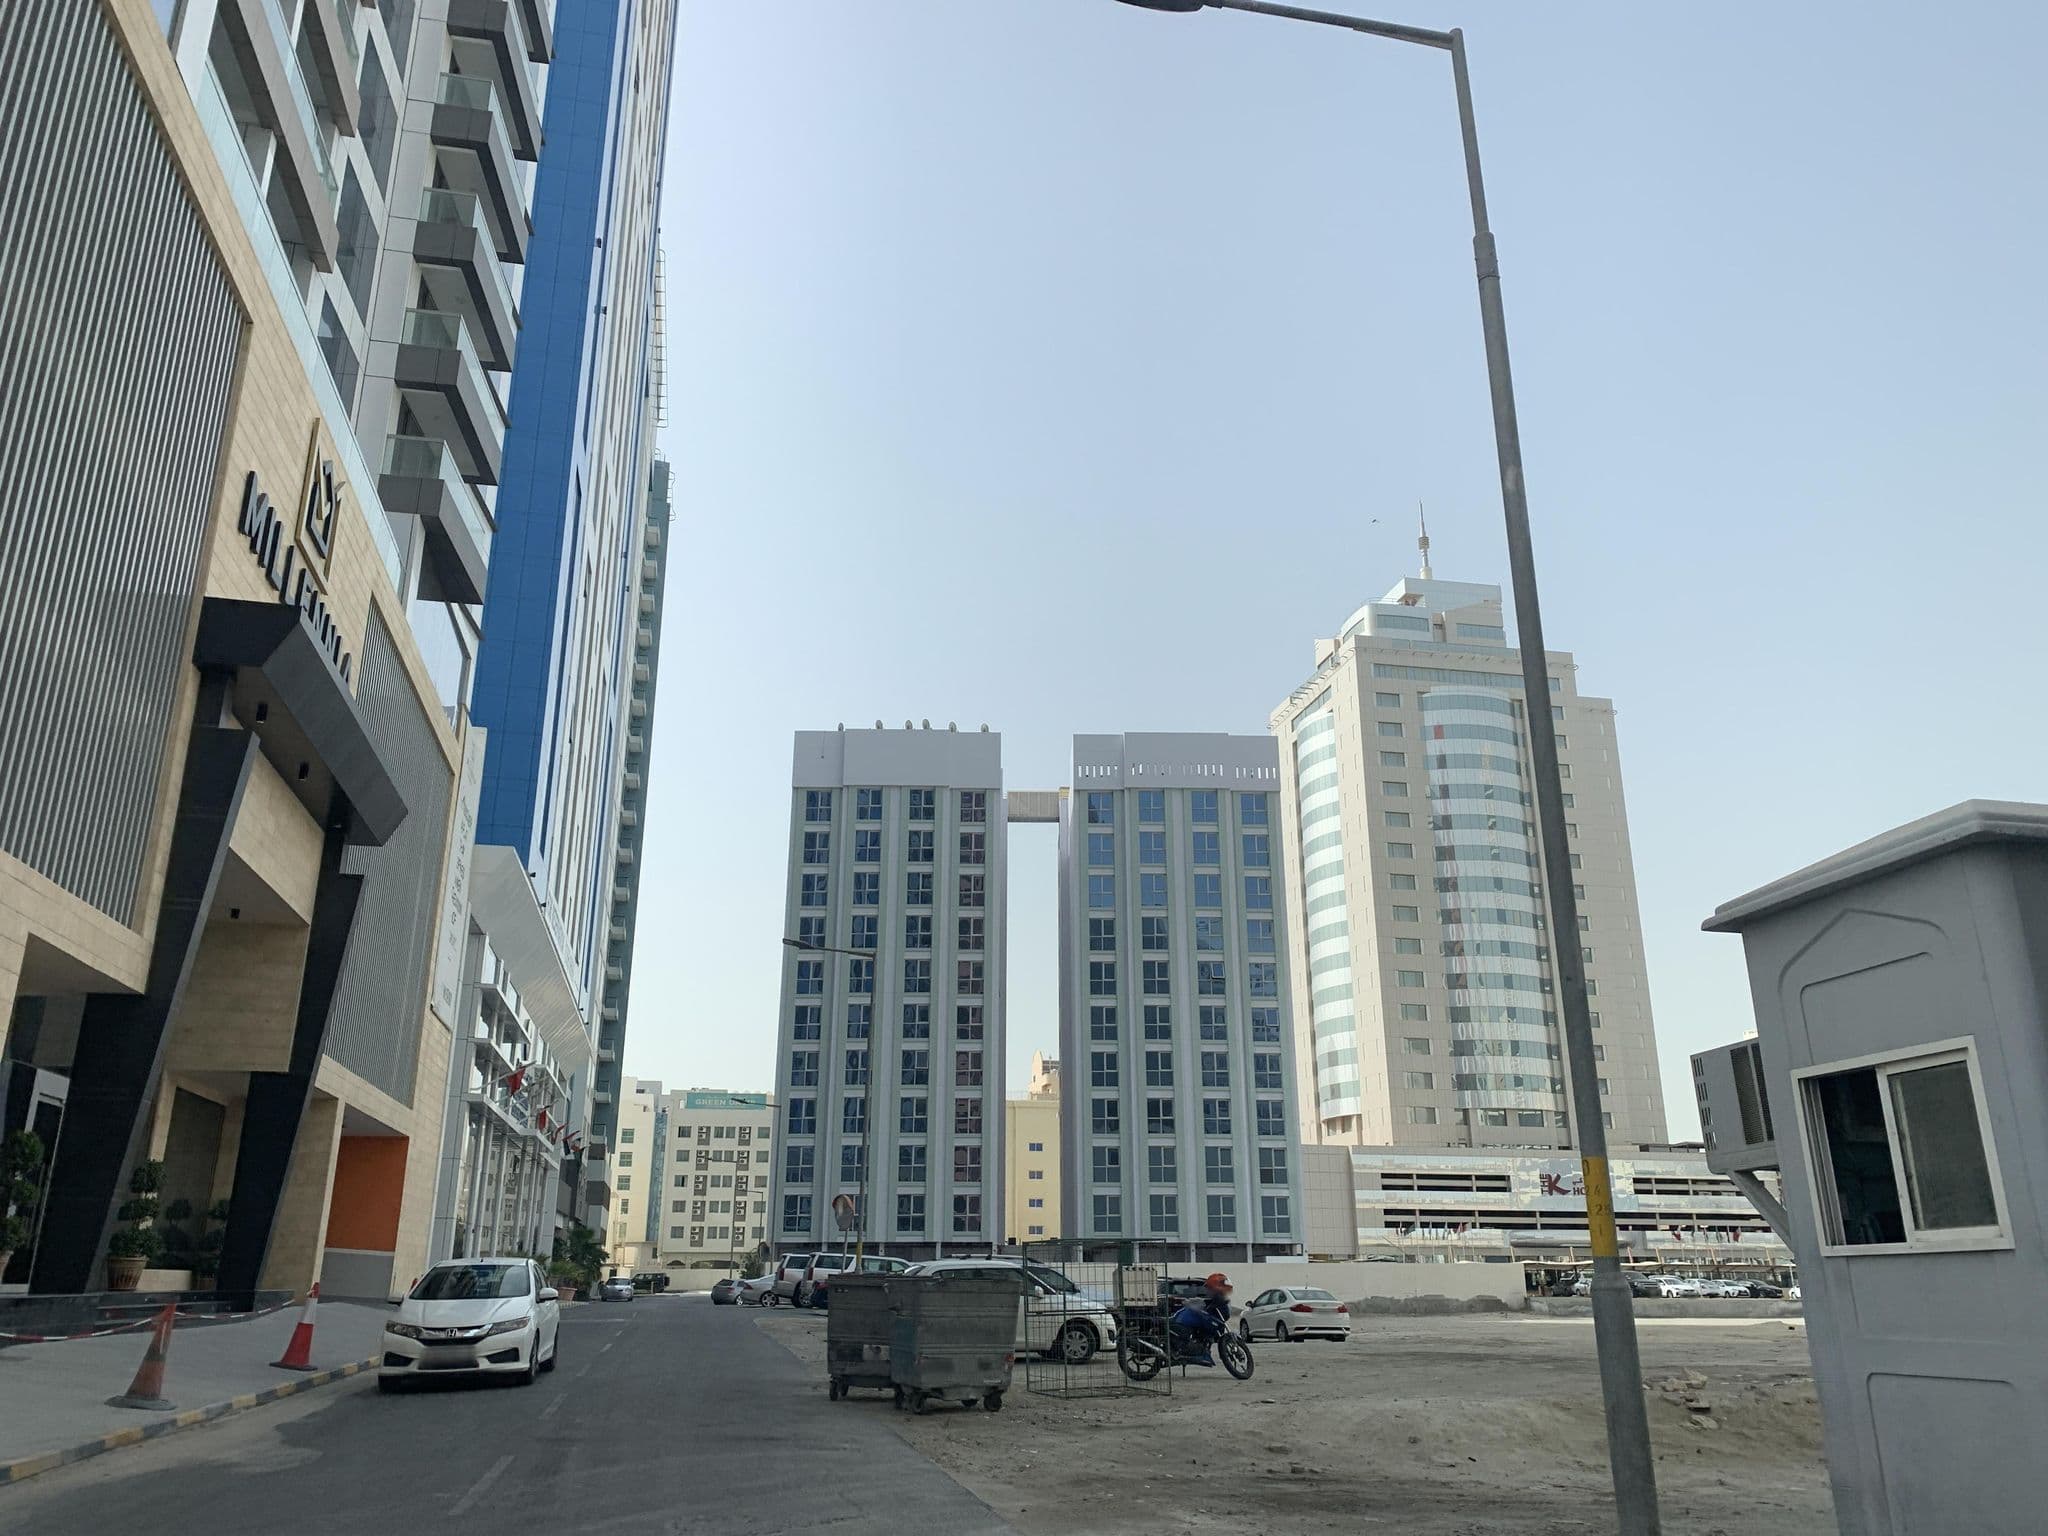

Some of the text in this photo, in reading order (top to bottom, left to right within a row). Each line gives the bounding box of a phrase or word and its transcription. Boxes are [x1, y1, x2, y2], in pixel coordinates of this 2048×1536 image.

[238, 470, 352, 684] MILLENNIA
[1539, 1173, 1548, 1195] THE
[1547, 1172, 1572, 1196] K
